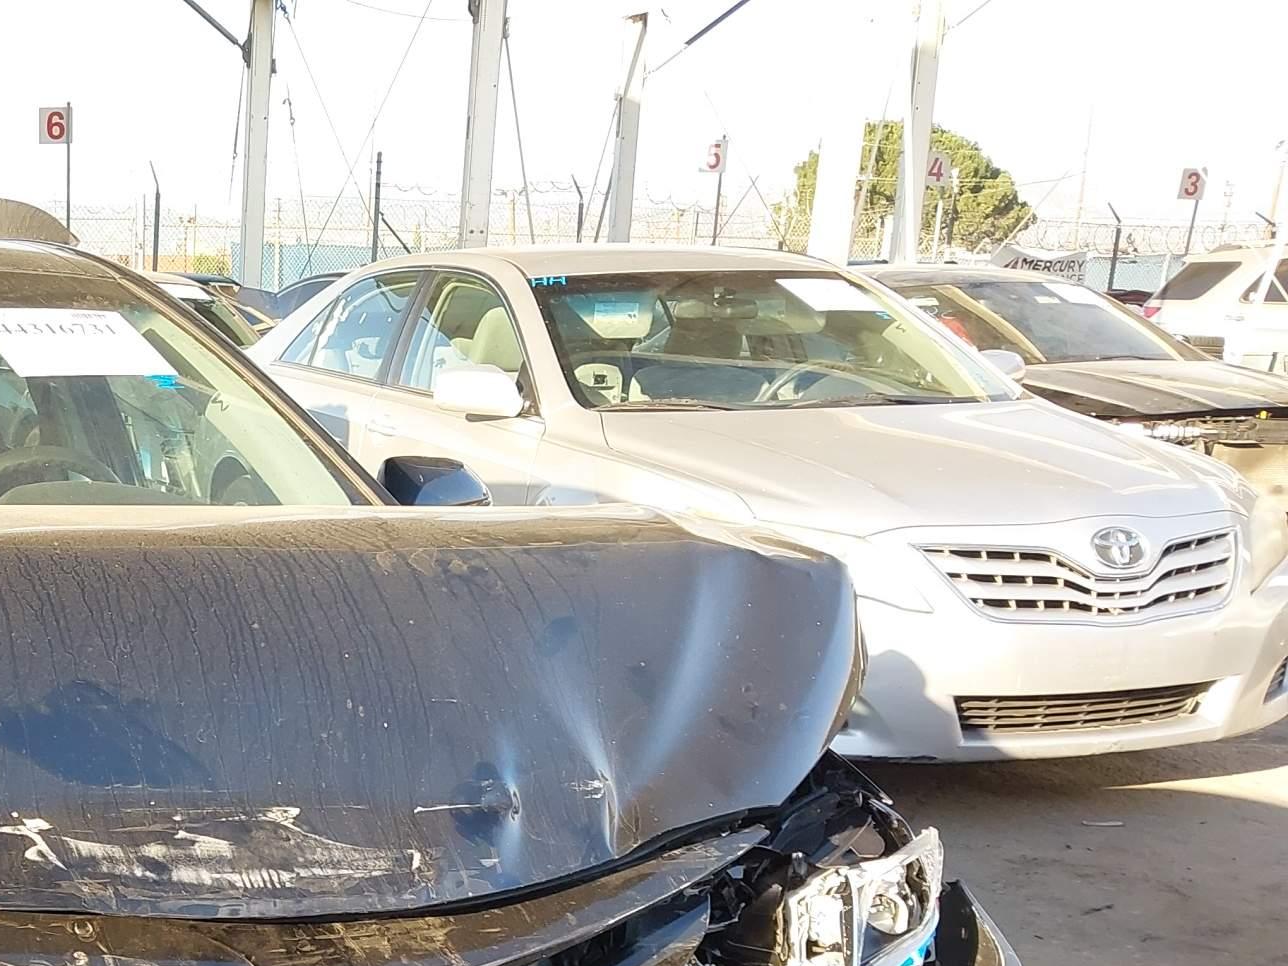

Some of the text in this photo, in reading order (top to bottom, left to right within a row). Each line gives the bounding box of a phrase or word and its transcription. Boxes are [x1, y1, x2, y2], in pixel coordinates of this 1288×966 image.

[46, 111, 66, 140] 6
[706, 143, 722, 170] 5
[927, 156, 944, 183] 4
[1183, 171, 1201, 197] 3
[1020, 257, 1085, 273] MERCURY
